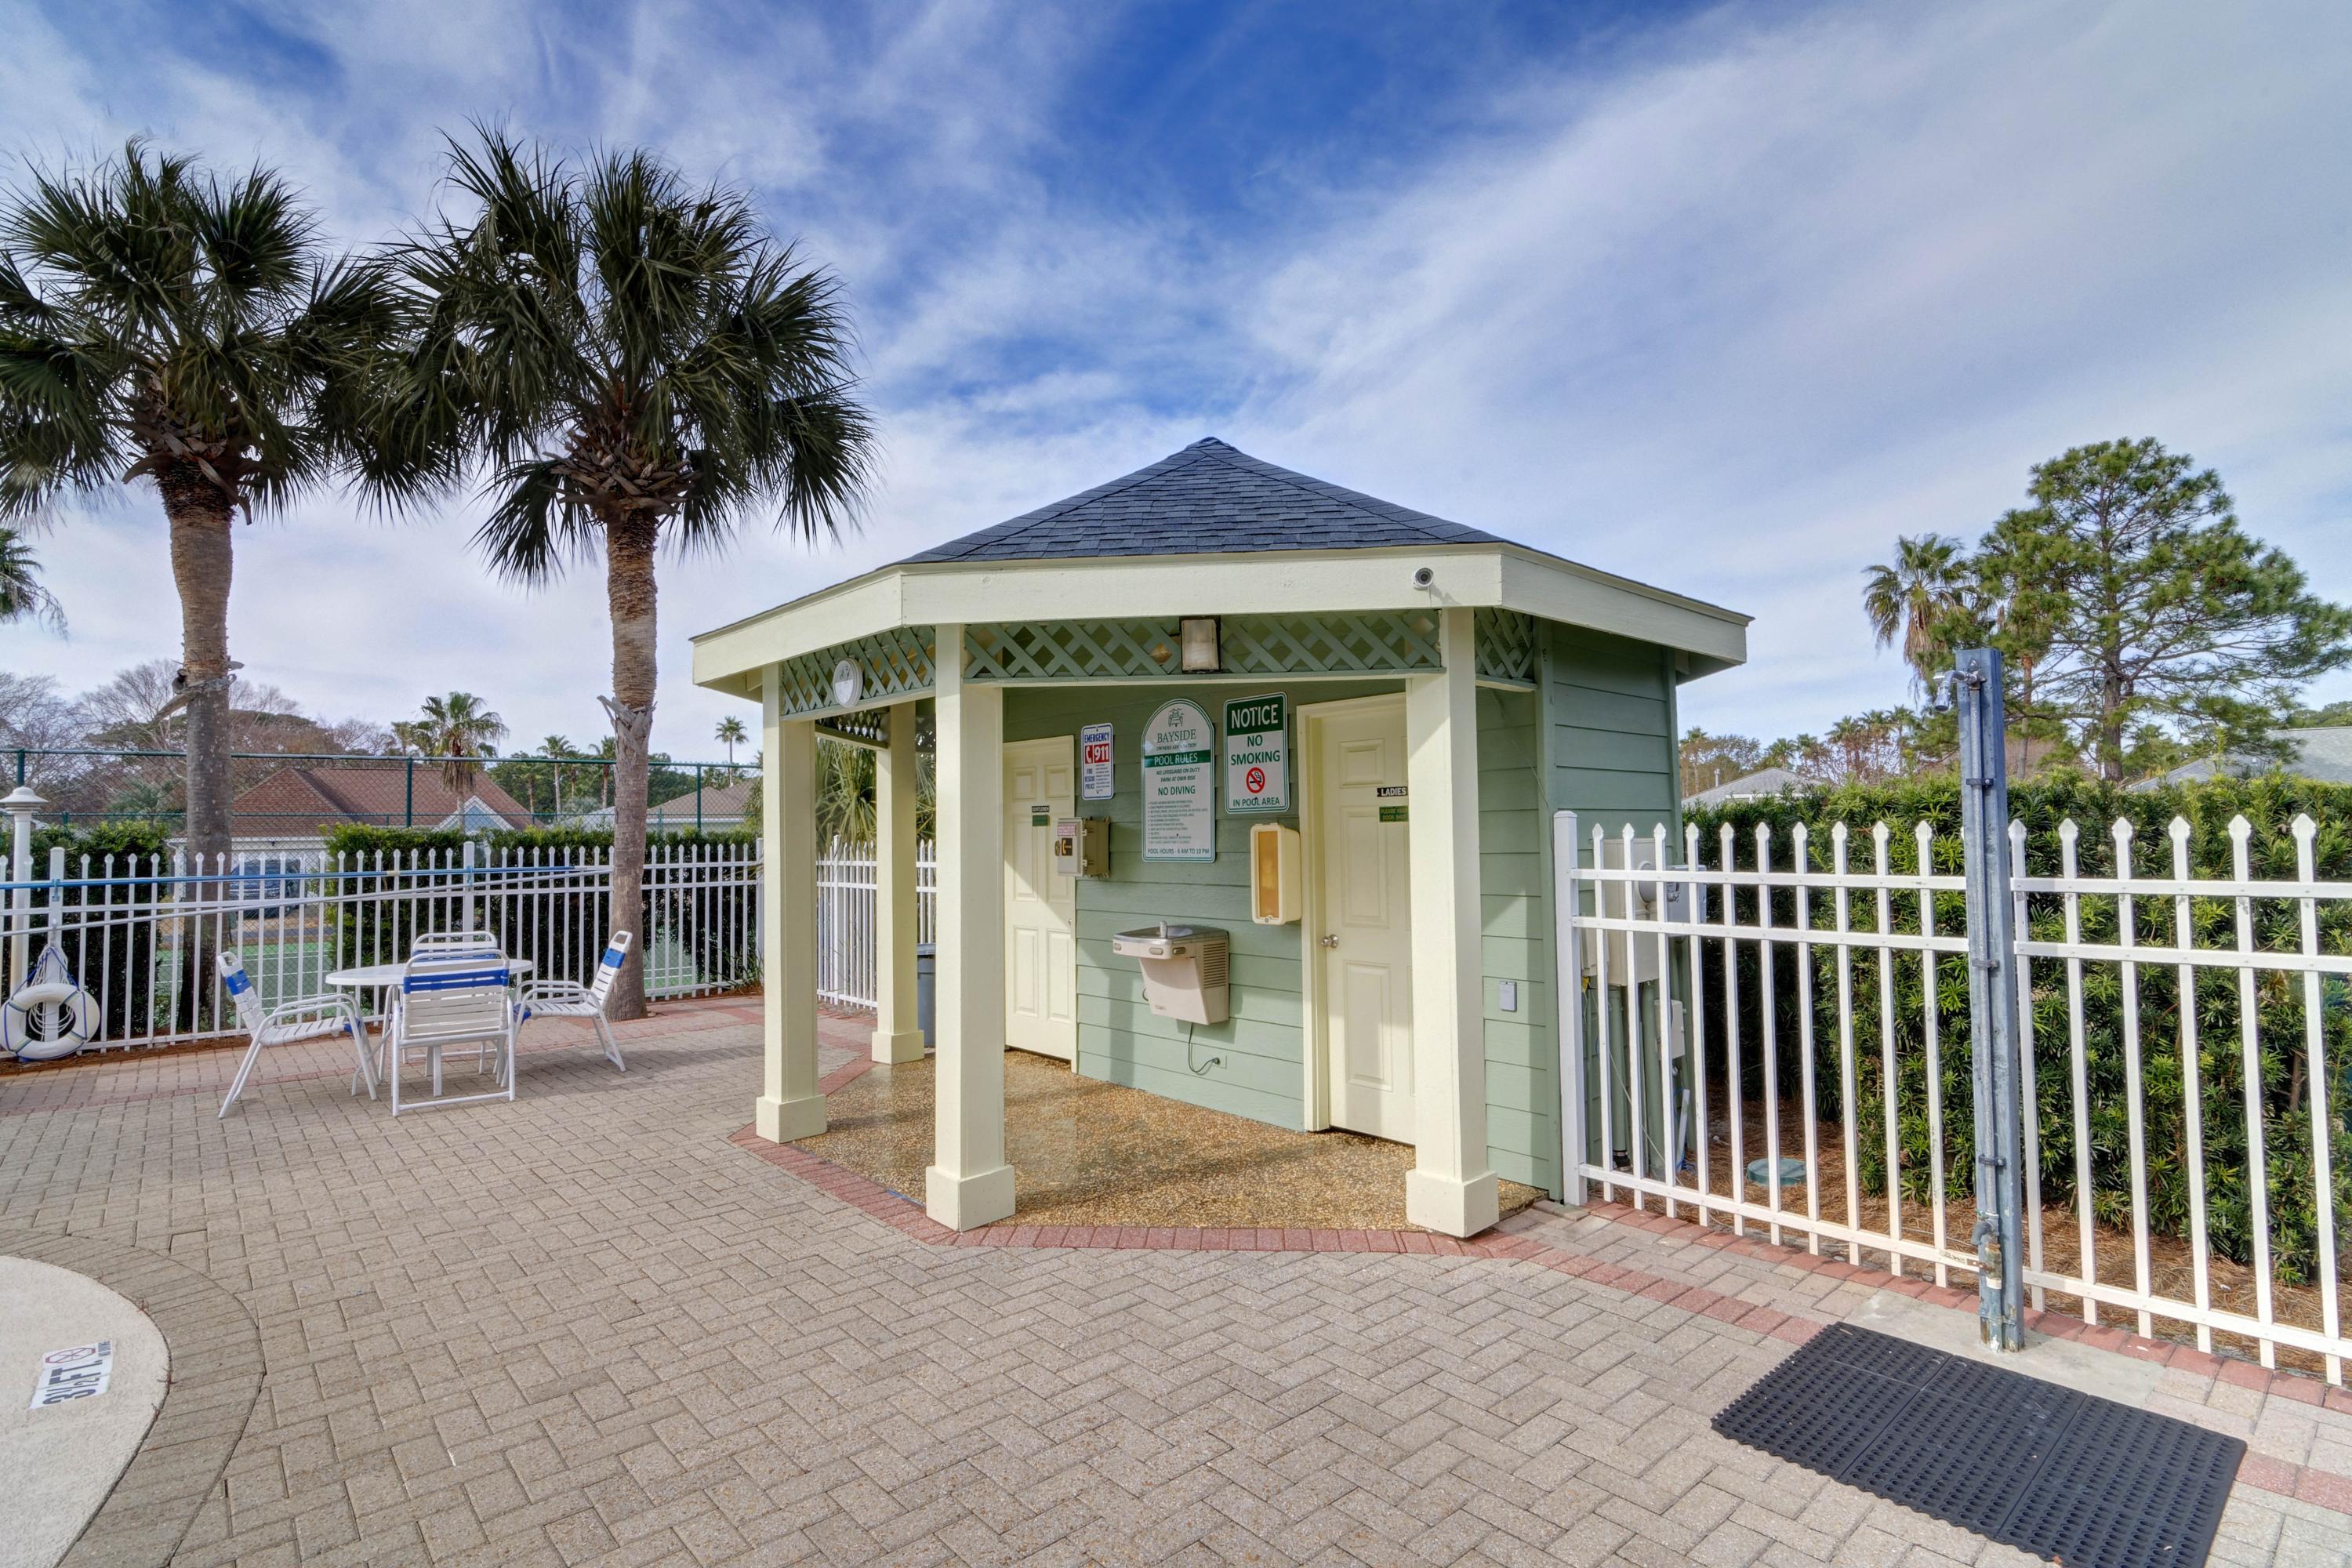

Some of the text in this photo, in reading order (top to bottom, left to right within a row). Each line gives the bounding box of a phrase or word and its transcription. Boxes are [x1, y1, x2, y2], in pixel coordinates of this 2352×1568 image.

[1231, 704, 1278, 729] NOTICE
[1084, 732, 1109, 743] EMERGENCY
[1157, 729, 1197, 743] BAYSIDE
[1247, 735, 1263, 747] NO
[1094, 745, 1109, 761] 911
[1231, 750, 1280, 766] SMOKING
[1154, 753, 1198, 766] POOL RULES
[1158, 785, 1196, 796] NO DIVING
[1381, 788, 1406, 796] LADIES
[1242, 798, 1260, 807] POOL
[1262, 797, 1280, 806] AREA
